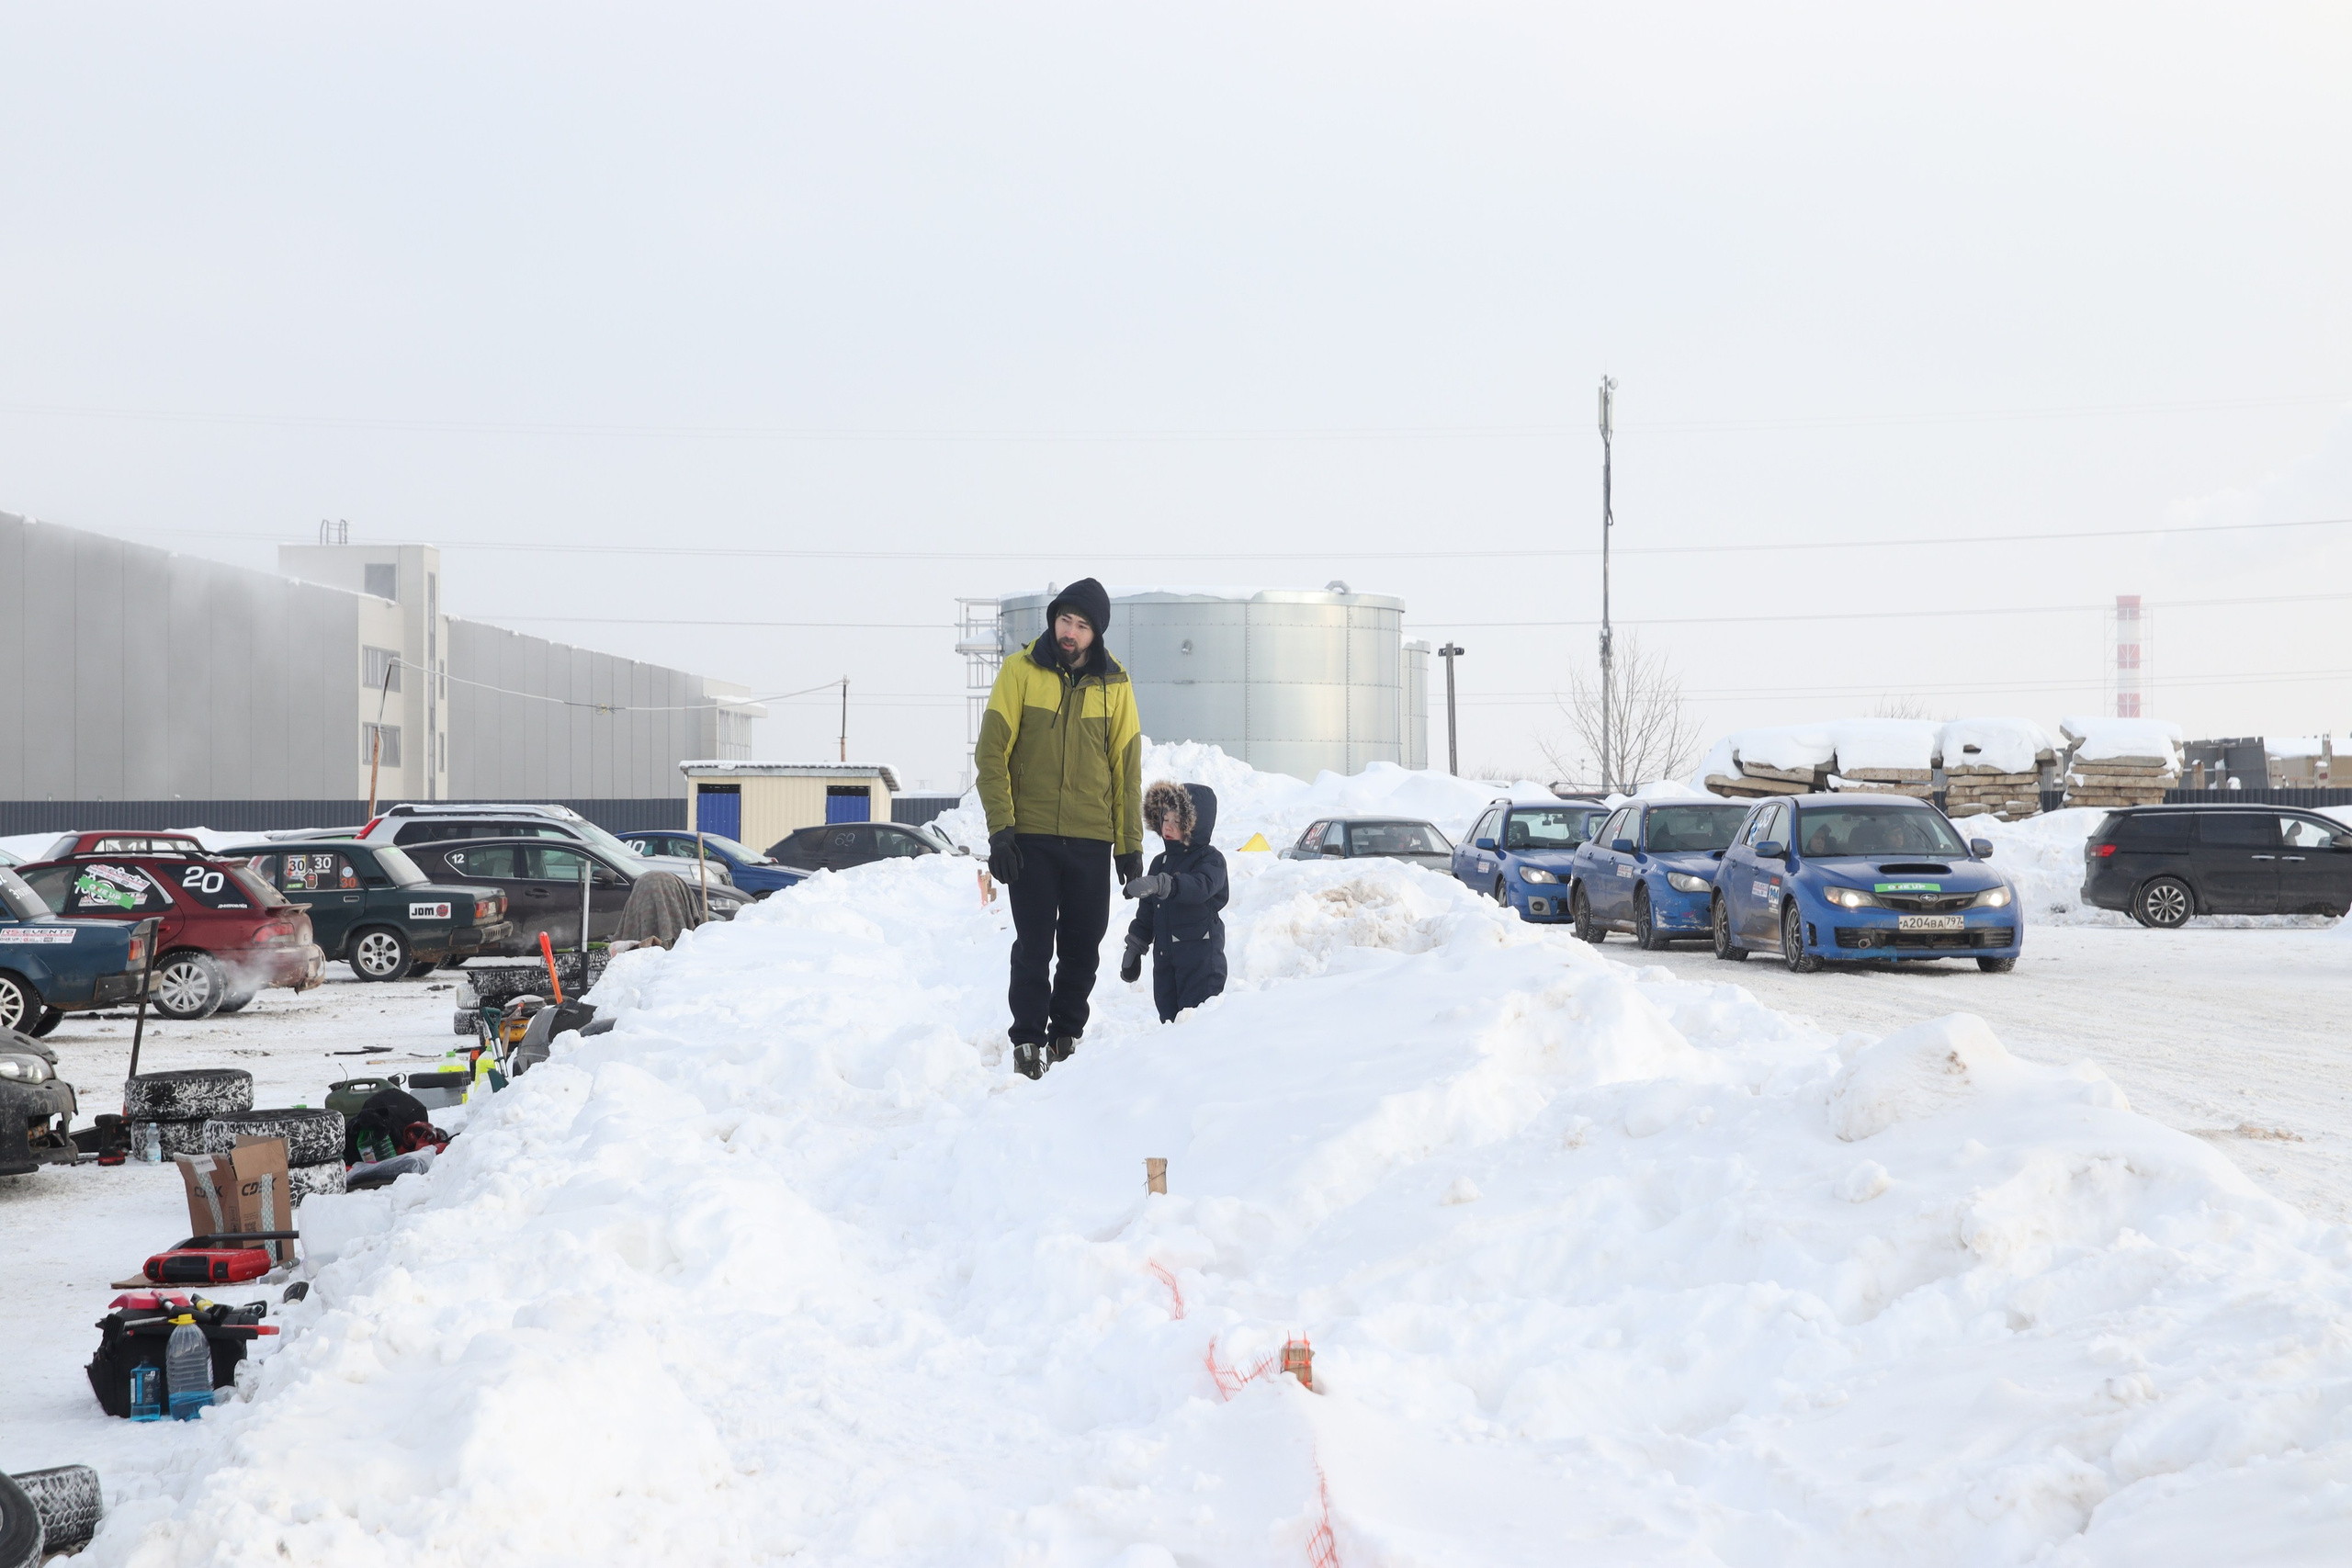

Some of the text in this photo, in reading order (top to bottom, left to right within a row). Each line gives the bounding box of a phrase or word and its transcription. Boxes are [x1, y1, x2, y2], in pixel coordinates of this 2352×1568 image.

[835, 832, 855, 846] 69
[314, 857, 332, 869] 30
[452, 853, 465, 863] 12
[289, 860, 305, 871] 30
[182, 866, 224, 893] 20
[341, 877, 356, 888] 30
[412, 907, 435, 916] JDM
[1946, 917, 1962, 925] 797
